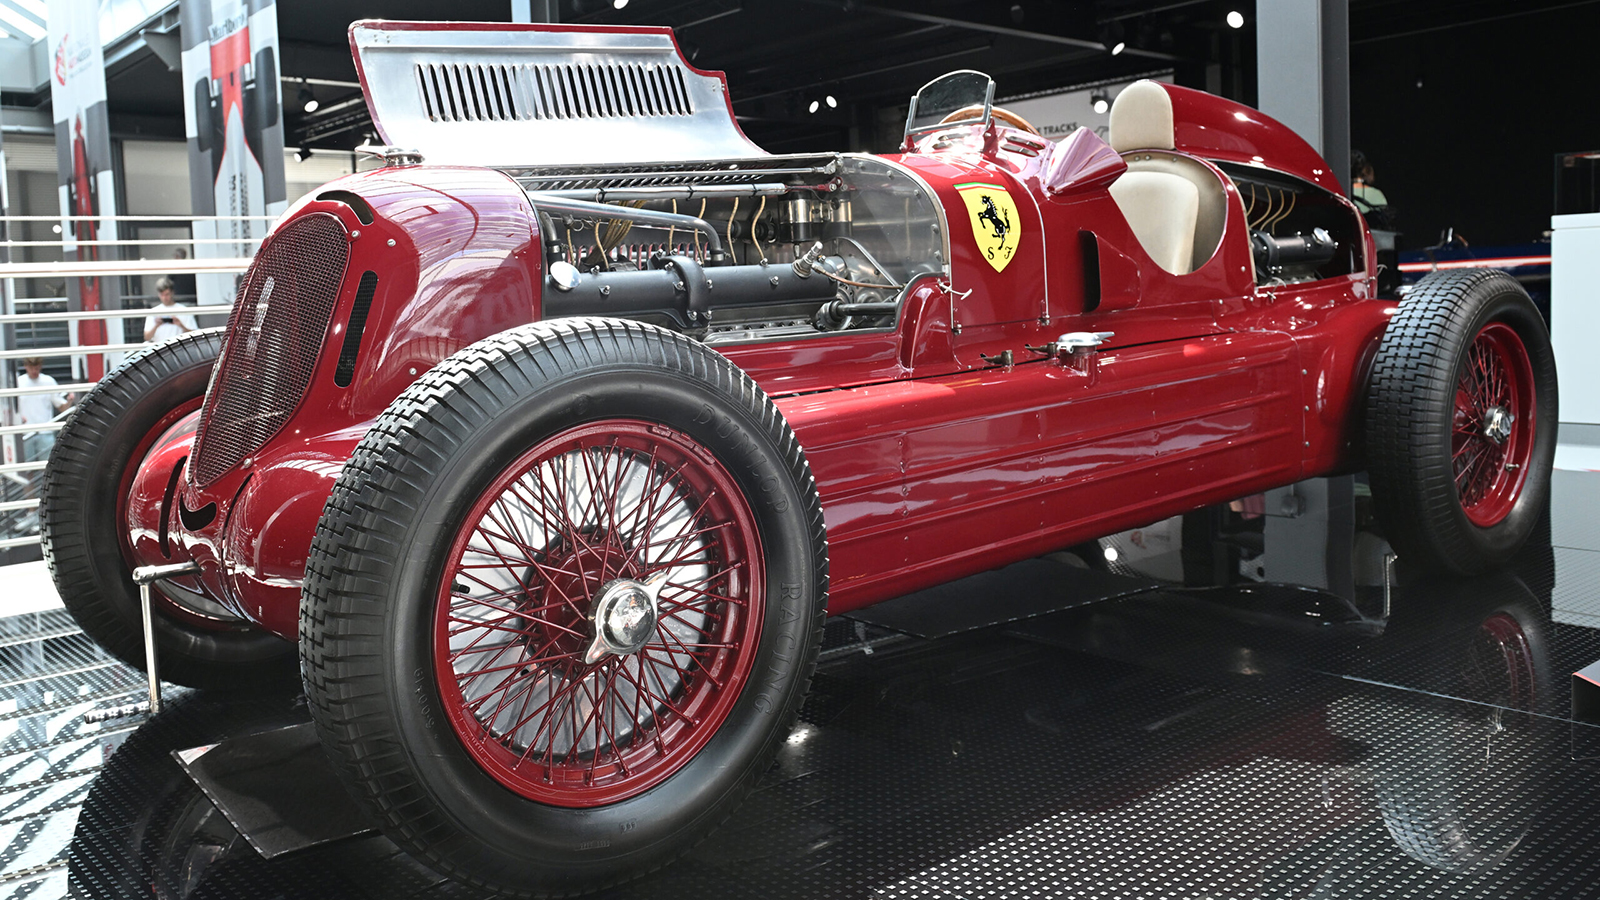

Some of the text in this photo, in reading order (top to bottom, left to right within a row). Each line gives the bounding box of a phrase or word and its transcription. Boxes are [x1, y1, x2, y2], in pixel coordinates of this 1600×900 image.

[1043, 122, 1078, 135] TRACKS
[987, 246, 995, 260] S
[693, 403, 789, 514] DUNLOP
[753, 581, 802, 715] RACING
